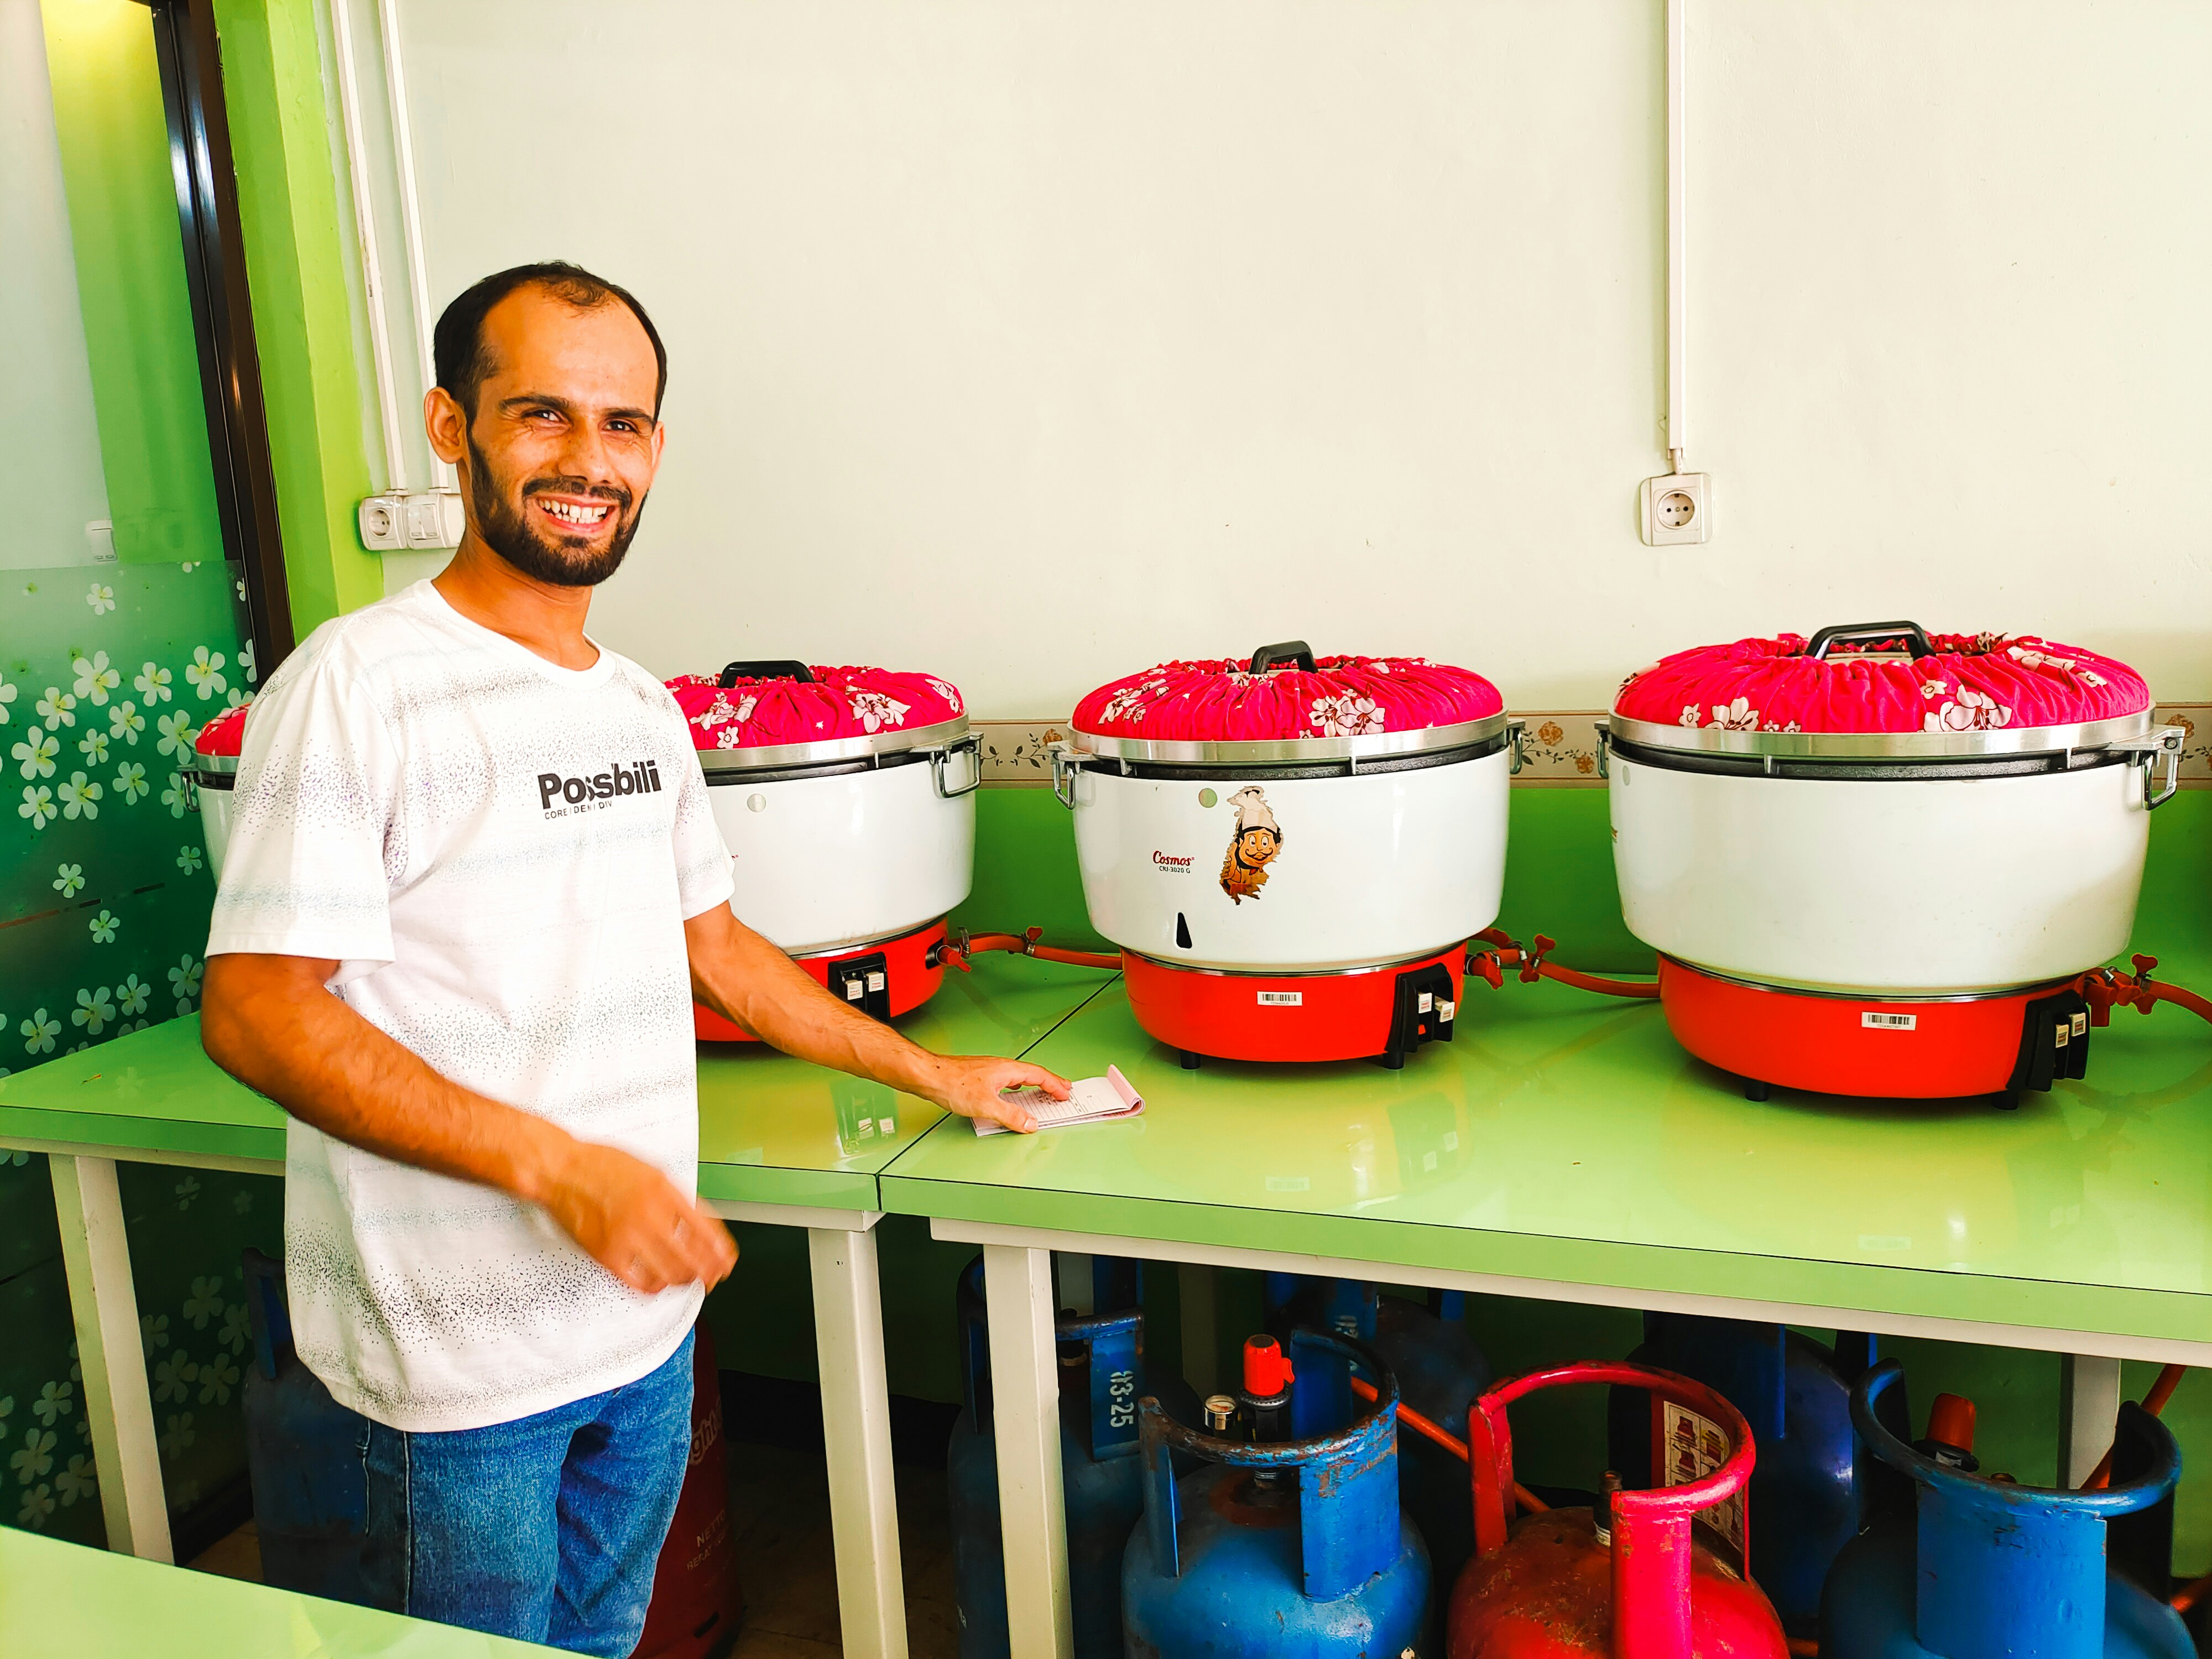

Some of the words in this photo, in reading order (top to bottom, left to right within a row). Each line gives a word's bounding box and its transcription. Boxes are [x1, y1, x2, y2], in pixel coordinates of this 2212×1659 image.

[545, 808, 568, 820] CORE
[598, 800, 612, 809] DIV
[696, 1508, 726, 1548] NETTO
